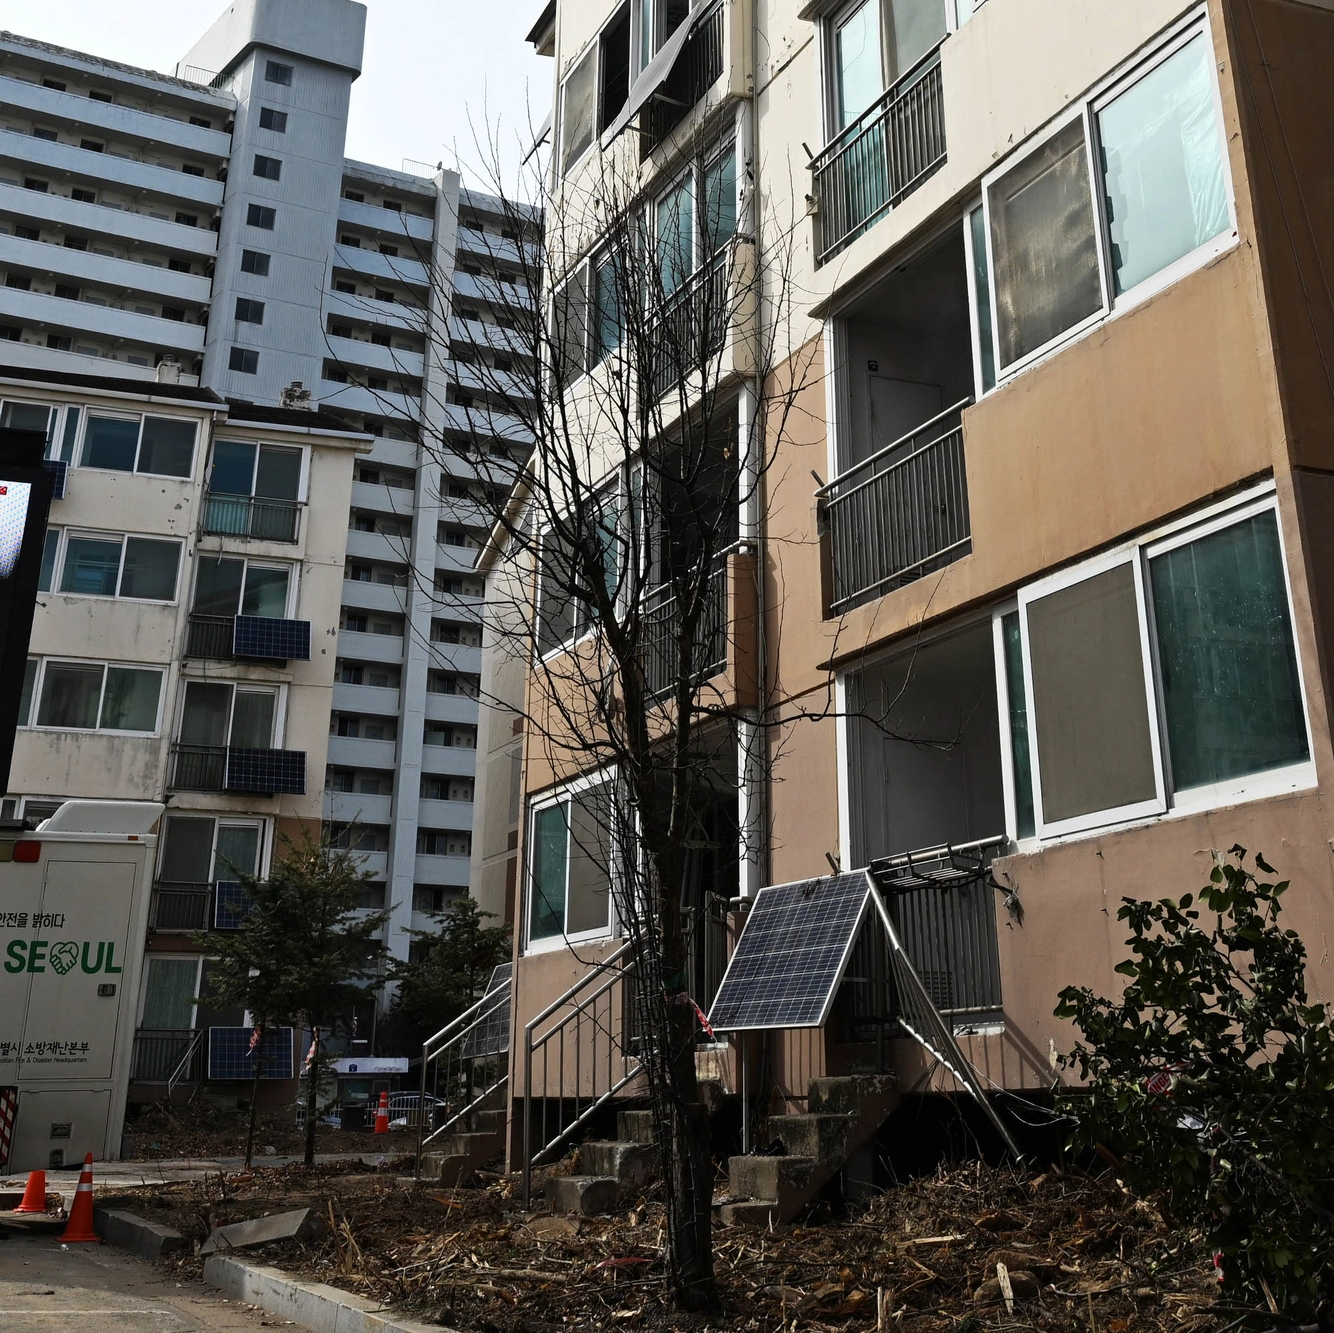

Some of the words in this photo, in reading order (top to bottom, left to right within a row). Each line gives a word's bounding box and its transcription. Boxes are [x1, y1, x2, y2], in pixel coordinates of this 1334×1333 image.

[32, 913, 65, 928] 밝히다
[4, 940, 123, 974] SEOUL
[24, 1042, 90, 1056] 소방재난본부
